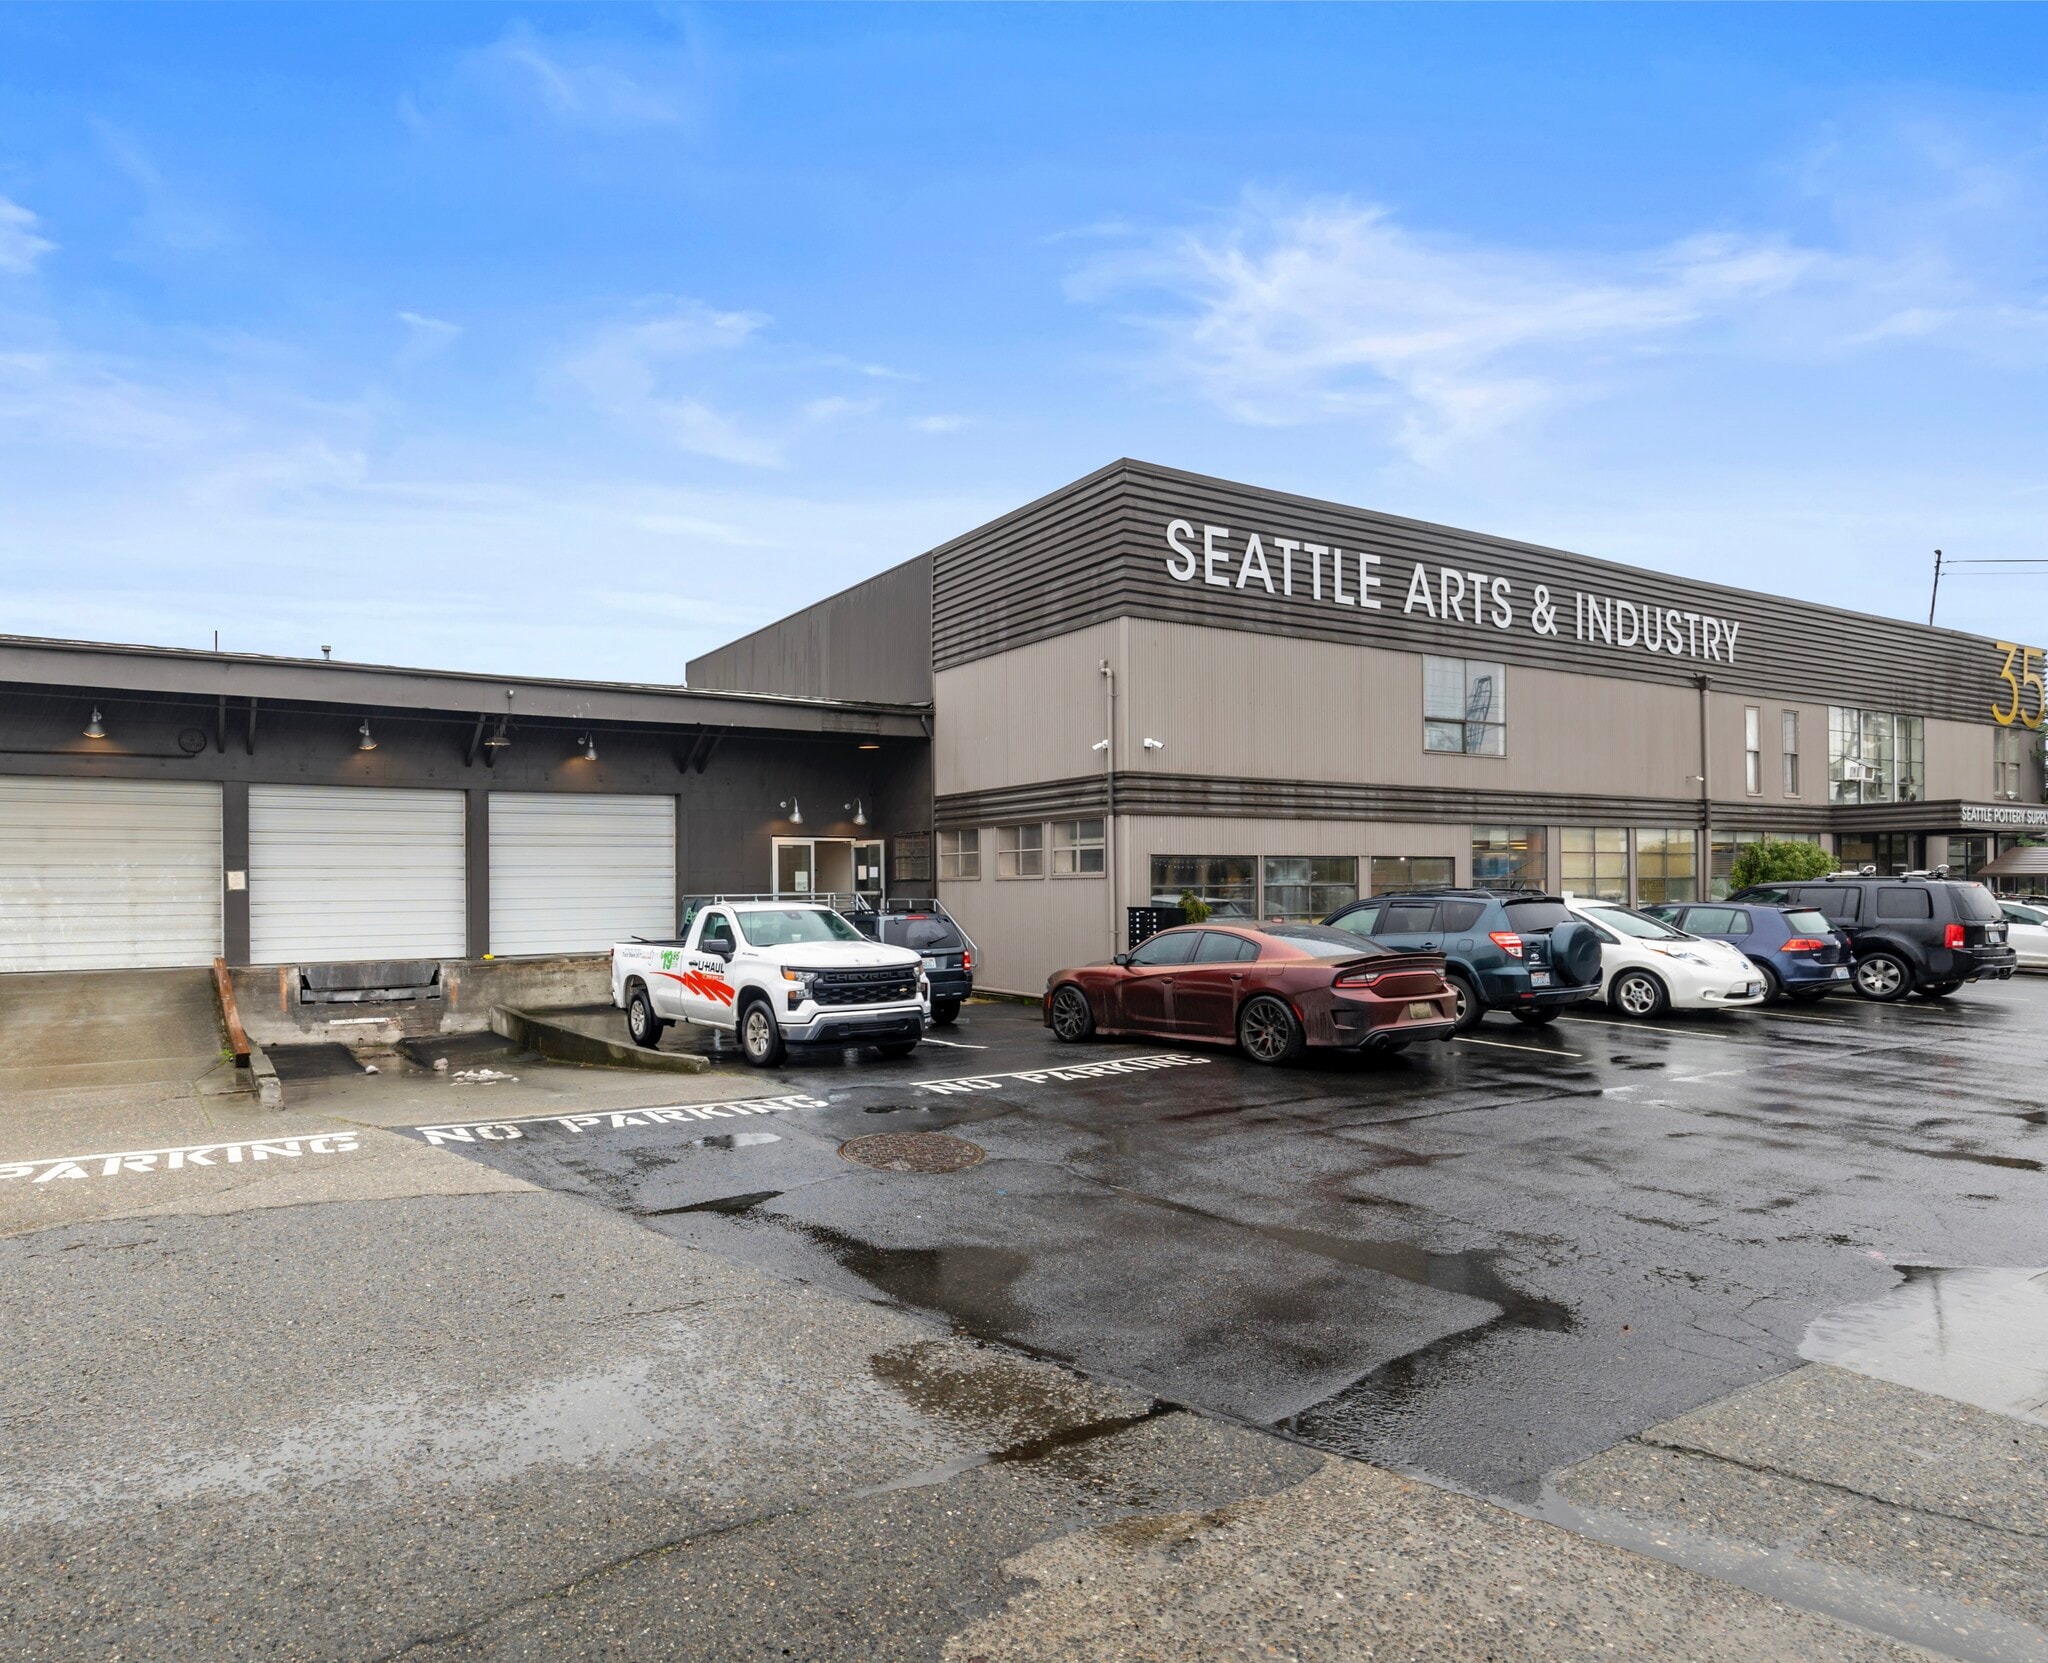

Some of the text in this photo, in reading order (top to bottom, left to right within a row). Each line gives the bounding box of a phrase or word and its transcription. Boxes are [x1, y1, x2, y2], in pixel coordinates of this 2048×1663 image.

[1165, 518, 1740, 664] SEATTLE ARTS & INDUSTRY
[1991, 640, 2045, 729] 35
[1961, 806, 2048, 825] SEATTLE POTTERY SUPPL
[825, 970, 915, 982] CHEVROLET
[920, 1054, 1212, 1095] NO PARKING
[421, 1095, 830, 1146] NO PARKING
